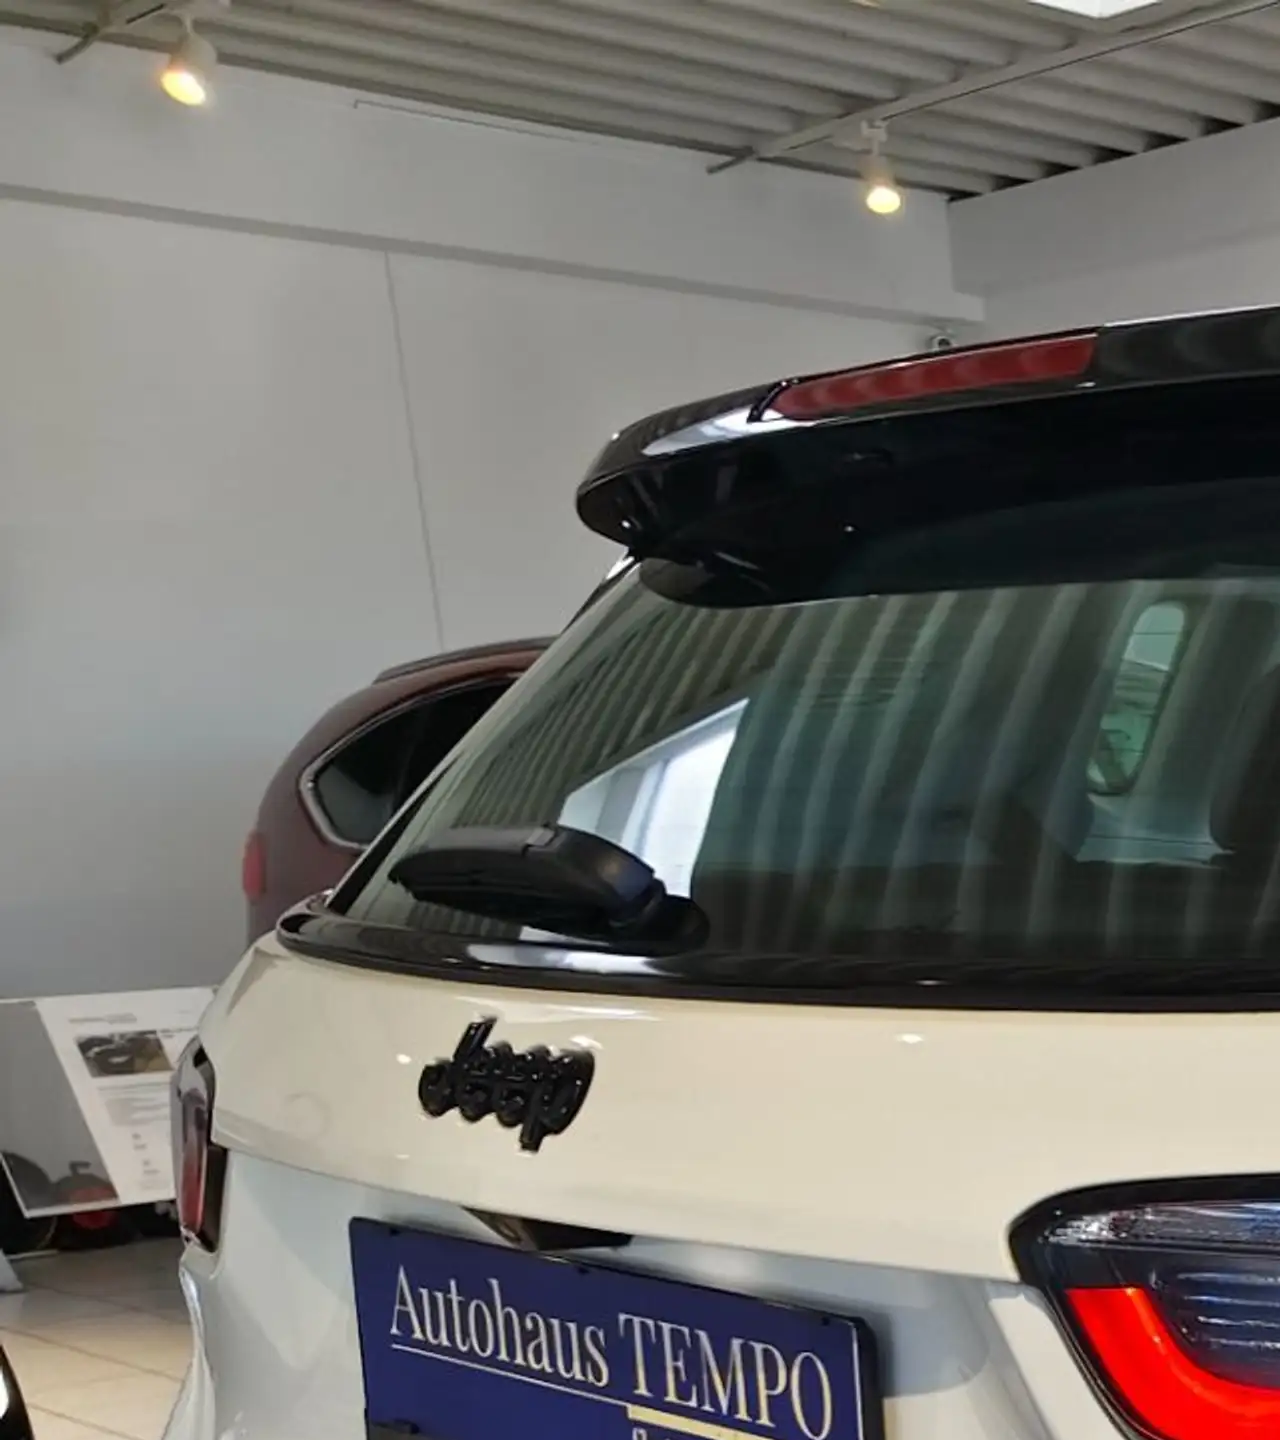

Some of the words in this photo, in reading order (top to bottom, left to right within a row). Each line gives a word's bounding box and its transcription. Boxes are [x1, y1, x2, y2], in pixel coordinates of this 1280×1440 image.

[419, 1016, 595, 1153] Jeep
[390, 1265, 610, 1388] Autohaus
[618, 1313, 833, 1440] TEMPO
